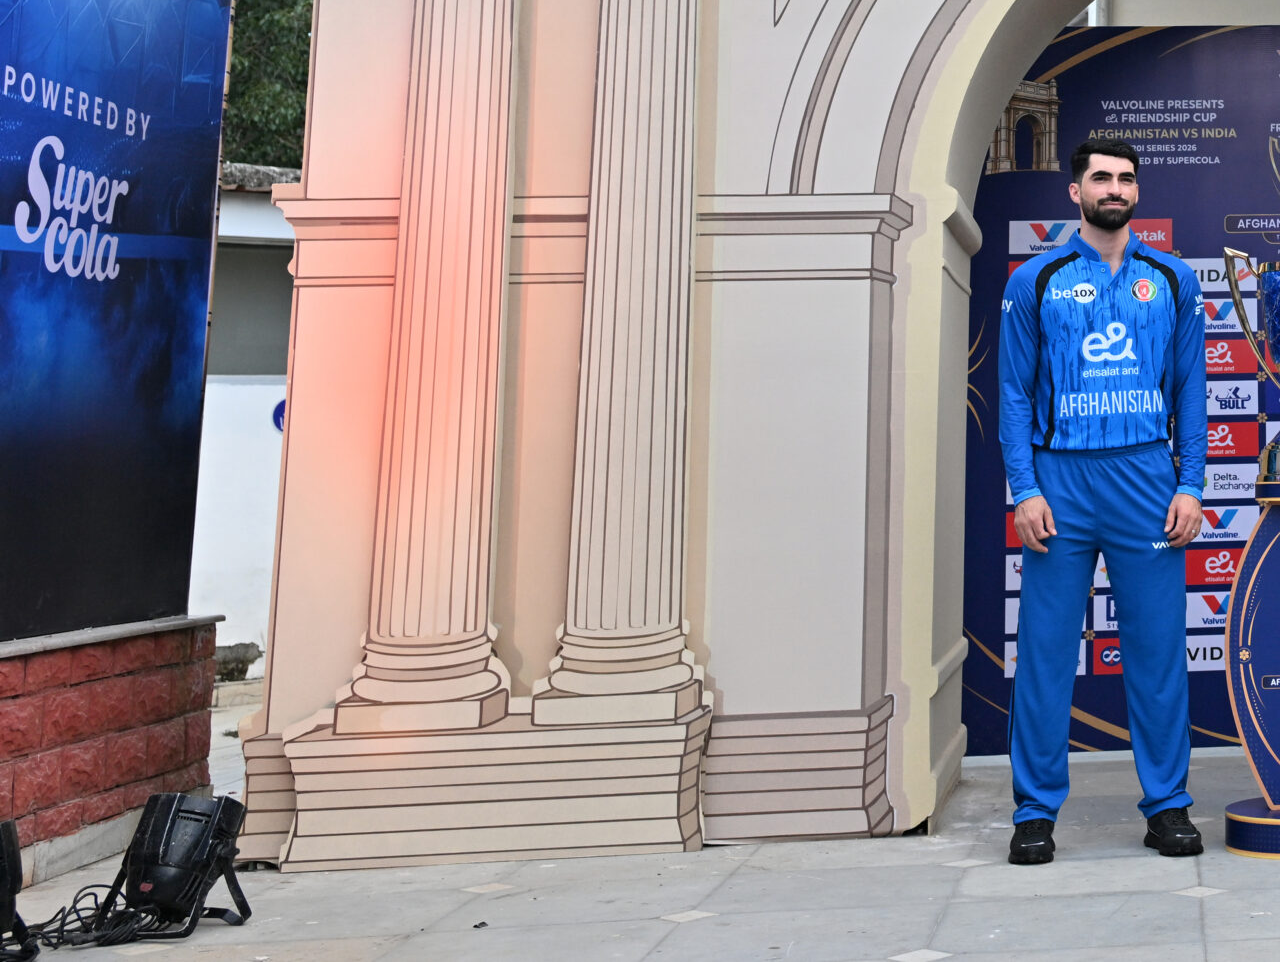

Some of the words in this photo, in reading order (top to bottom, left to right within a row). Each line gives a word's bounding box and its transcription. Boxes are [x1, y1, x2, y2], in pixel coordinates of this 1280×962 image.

[4, 64, 119, 131] POWERED
[125, 107, 151, 140] BY
[1101, 100, 1164, 110] VALVOLINE
[1167, 99, 1225, 110] PRESENTS
[1121, 113, 1190, 123] FRIENDSHIP
[1192, 112, 1217, 122] CUP
[1088, 128, 1179, 140] AFGHANISTAN
[1182, 128, 1199, 138] VS
[1201, 127, 1238, 138] INDIA
[1146, 144, 1176, 152] SERIES
[1177, 144, 1197, 152] 2026
[1153, 157, 1165, 165] BY
[1166, 156, 1221, 164] SUPERCOLA
[14, 135, 129, 244] Super
[1134, 230, 1166, 241] otak
[44, 216, 120, 282] cola
[1082, 367, 1121, 379] etisalat
[1122, 366, 1139, 376] and
[1060, 389, 1164, 418] AFGHANISTAN
[1219, 399, 1247, 410] BULL
[1213, 482, 1255, 492] Exchange
[1201, 531, 1239, 539] Valvoline
